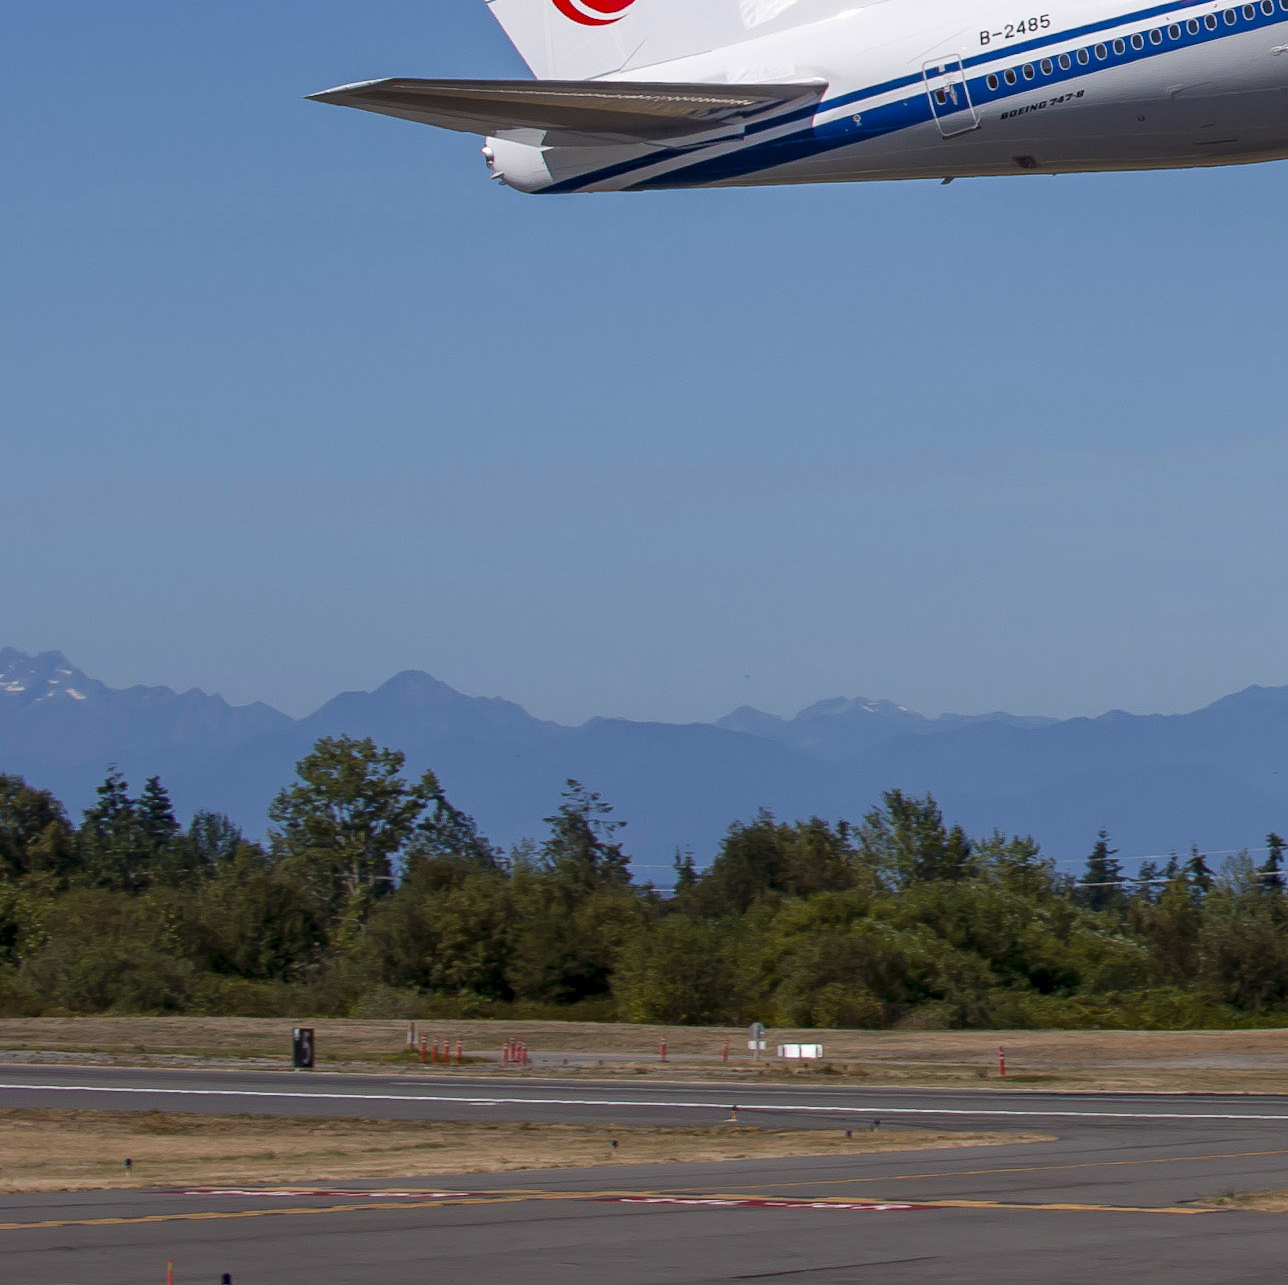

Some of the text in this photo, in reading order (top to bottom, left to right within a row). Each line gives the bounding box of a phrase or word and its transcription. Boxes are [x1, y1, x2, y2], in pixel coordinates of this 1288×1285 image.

[980, 14, 1051, 46] B-2485
[1000, 89, 1085, 120] BOEING 747-8
